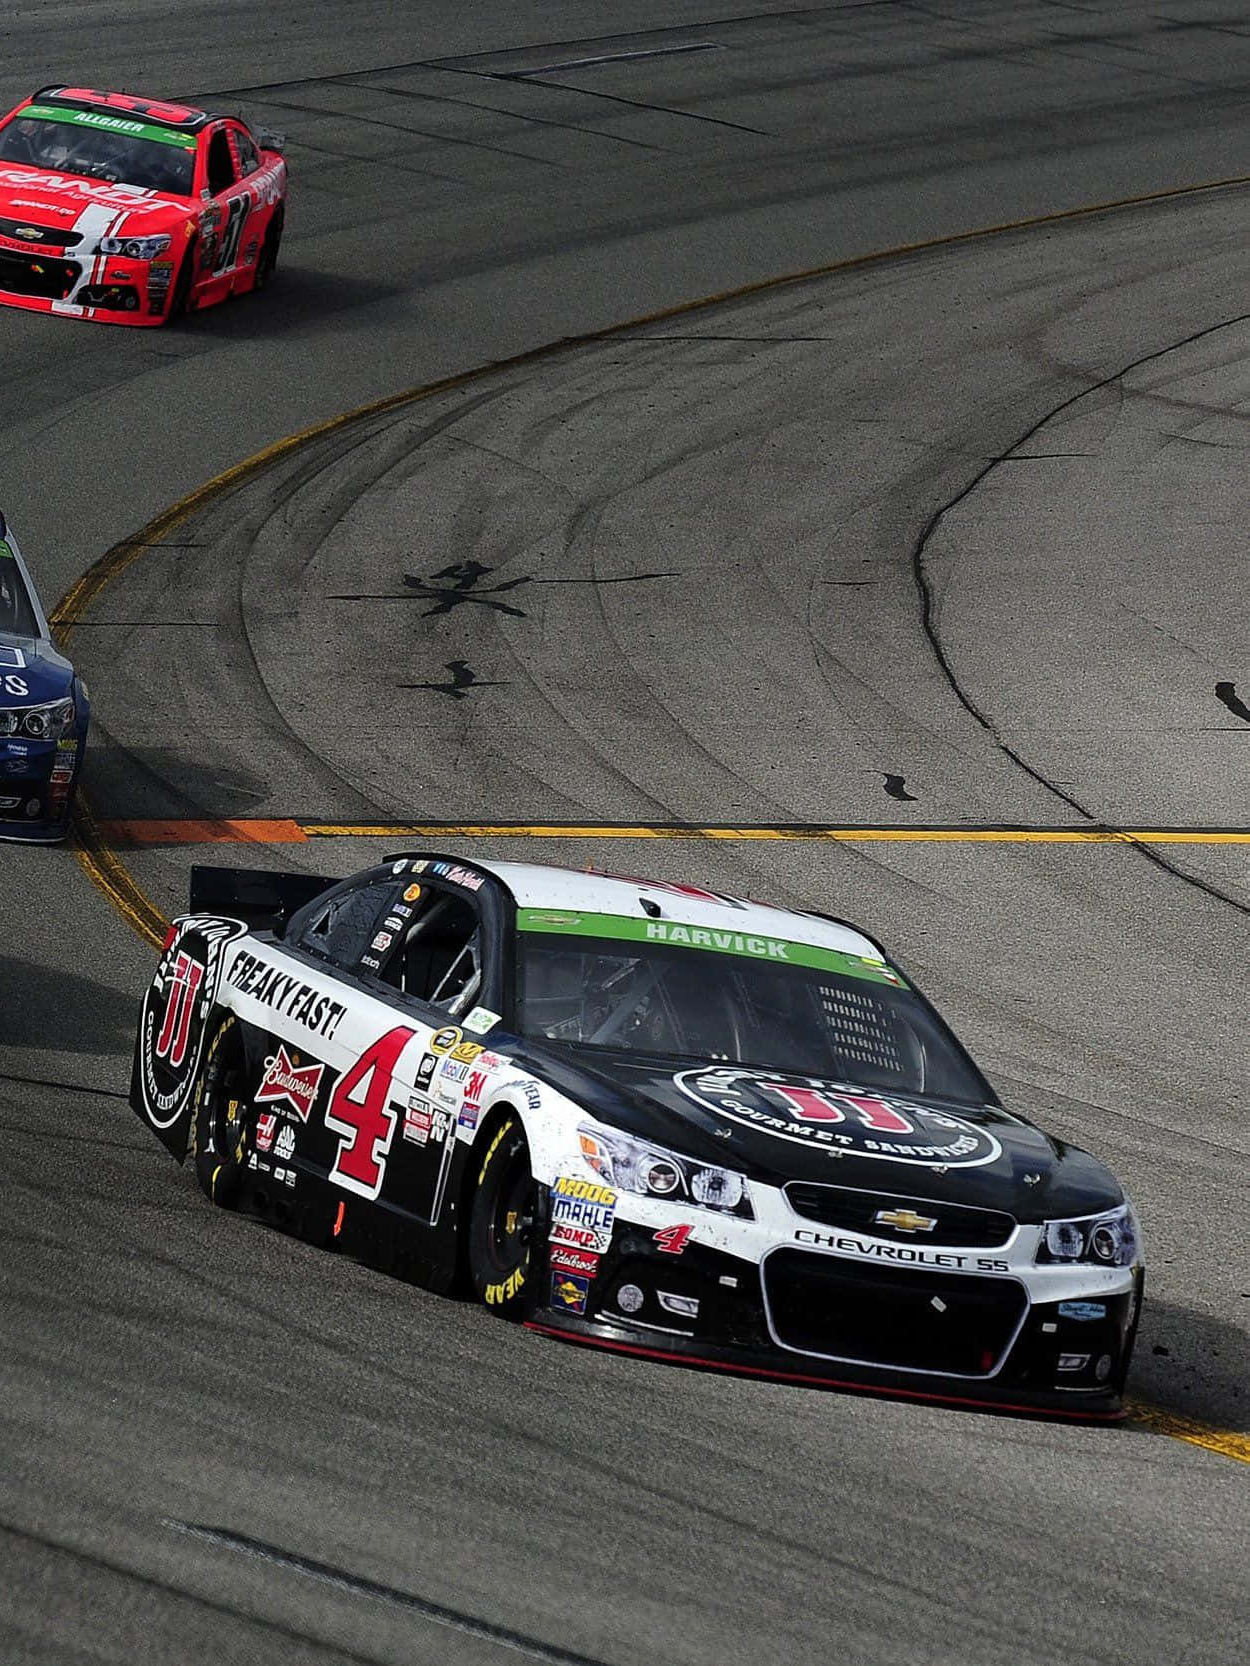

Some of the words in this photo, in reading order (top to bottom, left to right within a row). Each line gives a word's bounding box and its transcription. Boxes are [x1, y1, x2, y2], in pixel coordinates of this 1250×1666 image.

[73, 112, 144, 132] ALLGAIER
[646, 922, 790, 959] HARVICK
[226, 950, 296, 1011] FREAKY
[285, 983, 348, 1041] FAST!
[463, 1070, 489, 1102] 3M
[326, 1024, 418, 1200] 4
[720, 1099, 854, 1146] GOURMET
[554, 1176, 617, 1206] MOOG
[554, 1199, 613, 1229] MAHLE
[553, 1224, 595, 1246] COMP
[653, 1224, 696, 1254] 4
[550, 1249, 598, 1273] Edelbrock
[794, 1229, 968, 1268] CHEVROLET
[976, 1258, 1010, 1273] SS
